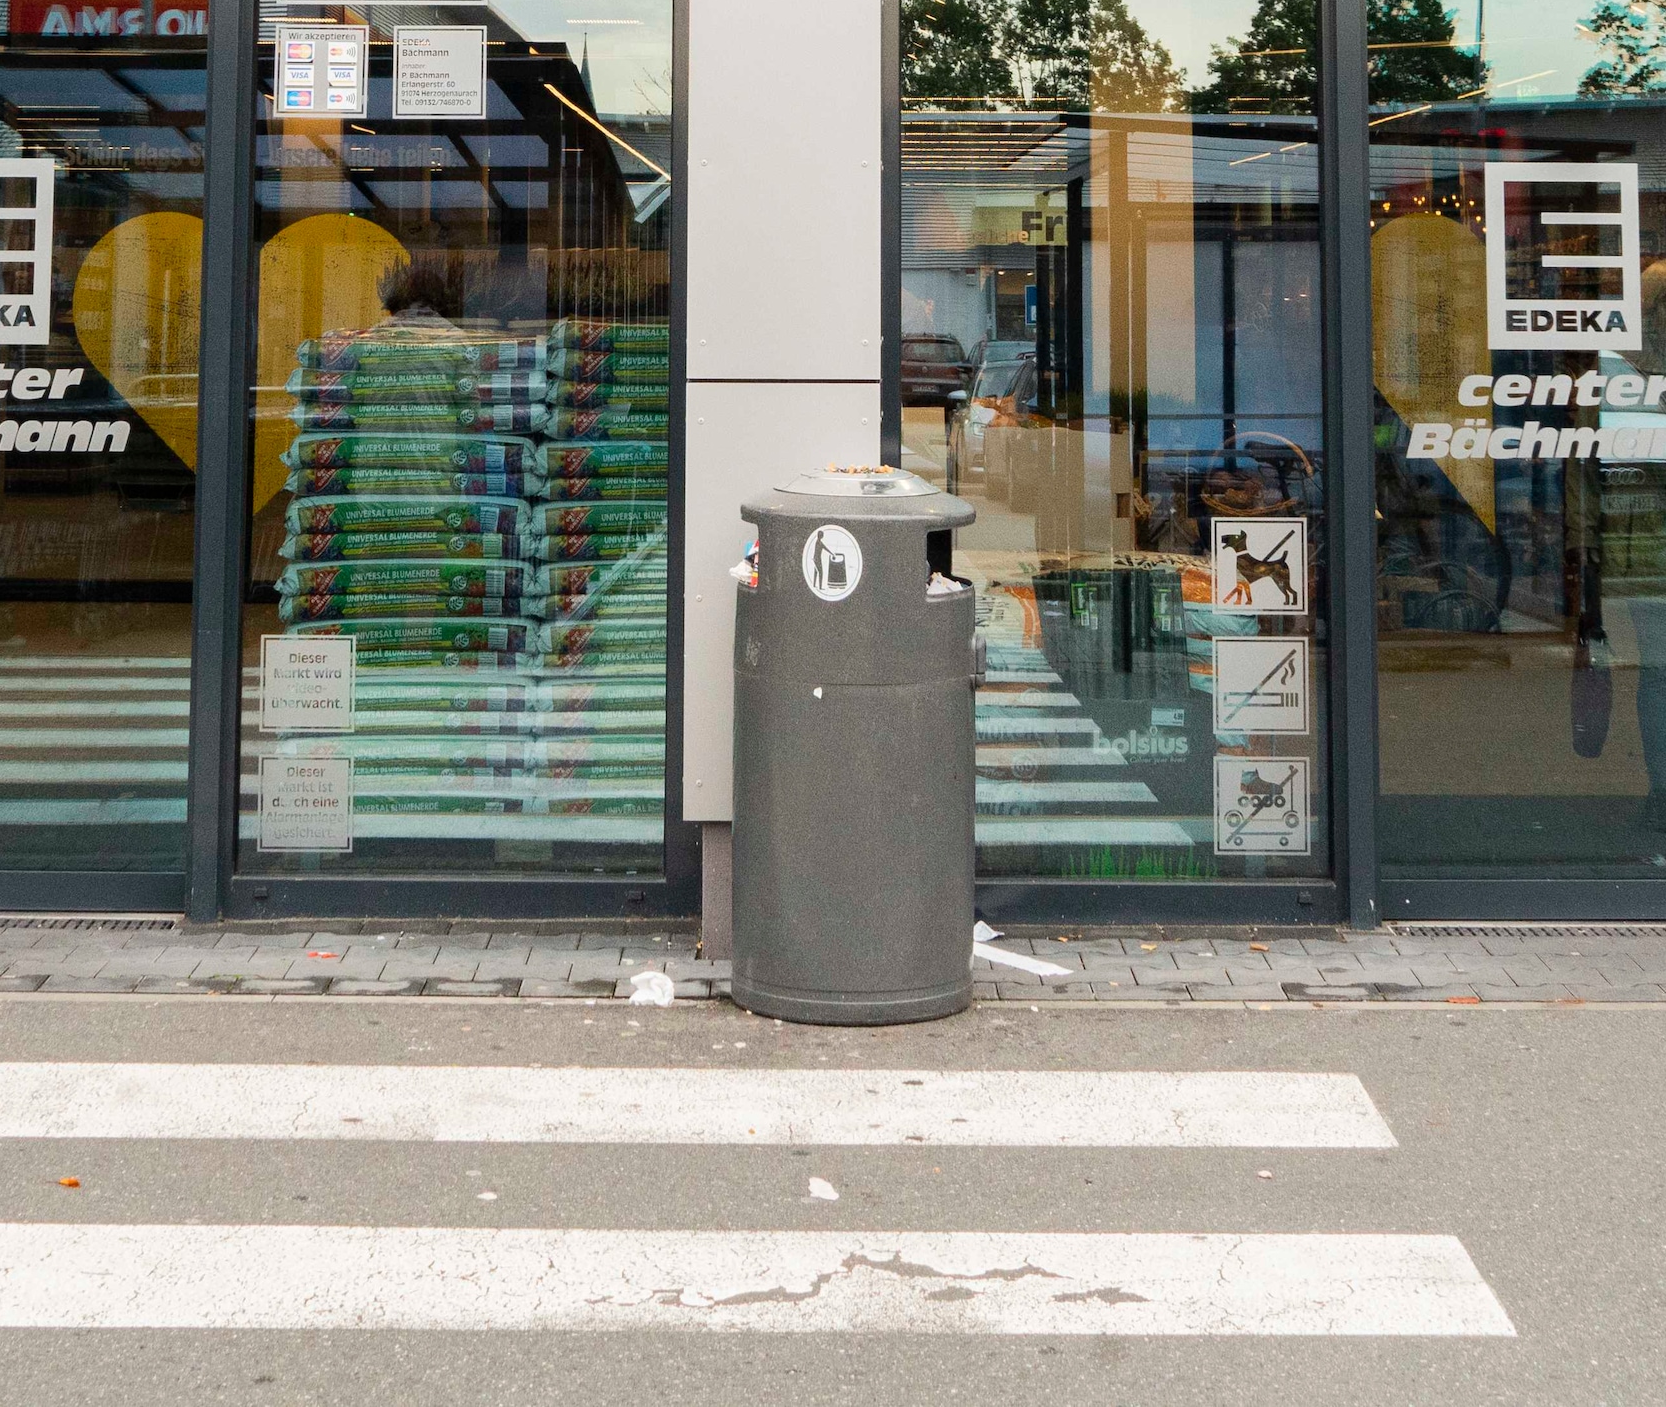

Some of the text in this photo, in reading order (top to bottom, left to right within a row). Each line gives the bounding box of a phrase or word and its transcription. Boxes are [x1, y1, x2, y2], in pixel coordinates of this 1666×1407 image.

[288, 32, 357, 42] Wir akzeptieren
[1505, 310, 1627, 332] EDEKA
[345, 508, 386, 519] UNIVERSAL
[388, 506, 435, 517] BLUMENERDE
[350, 569, 440, 582] UNIVERSAL BLUMENERDE
[394, 626, 442, 637] BLUMENERDE
[289, 652, 328, 664] Dieser
[314, 667, 342, 678] wird
[1093, 725, 1189, 755] bolsius
